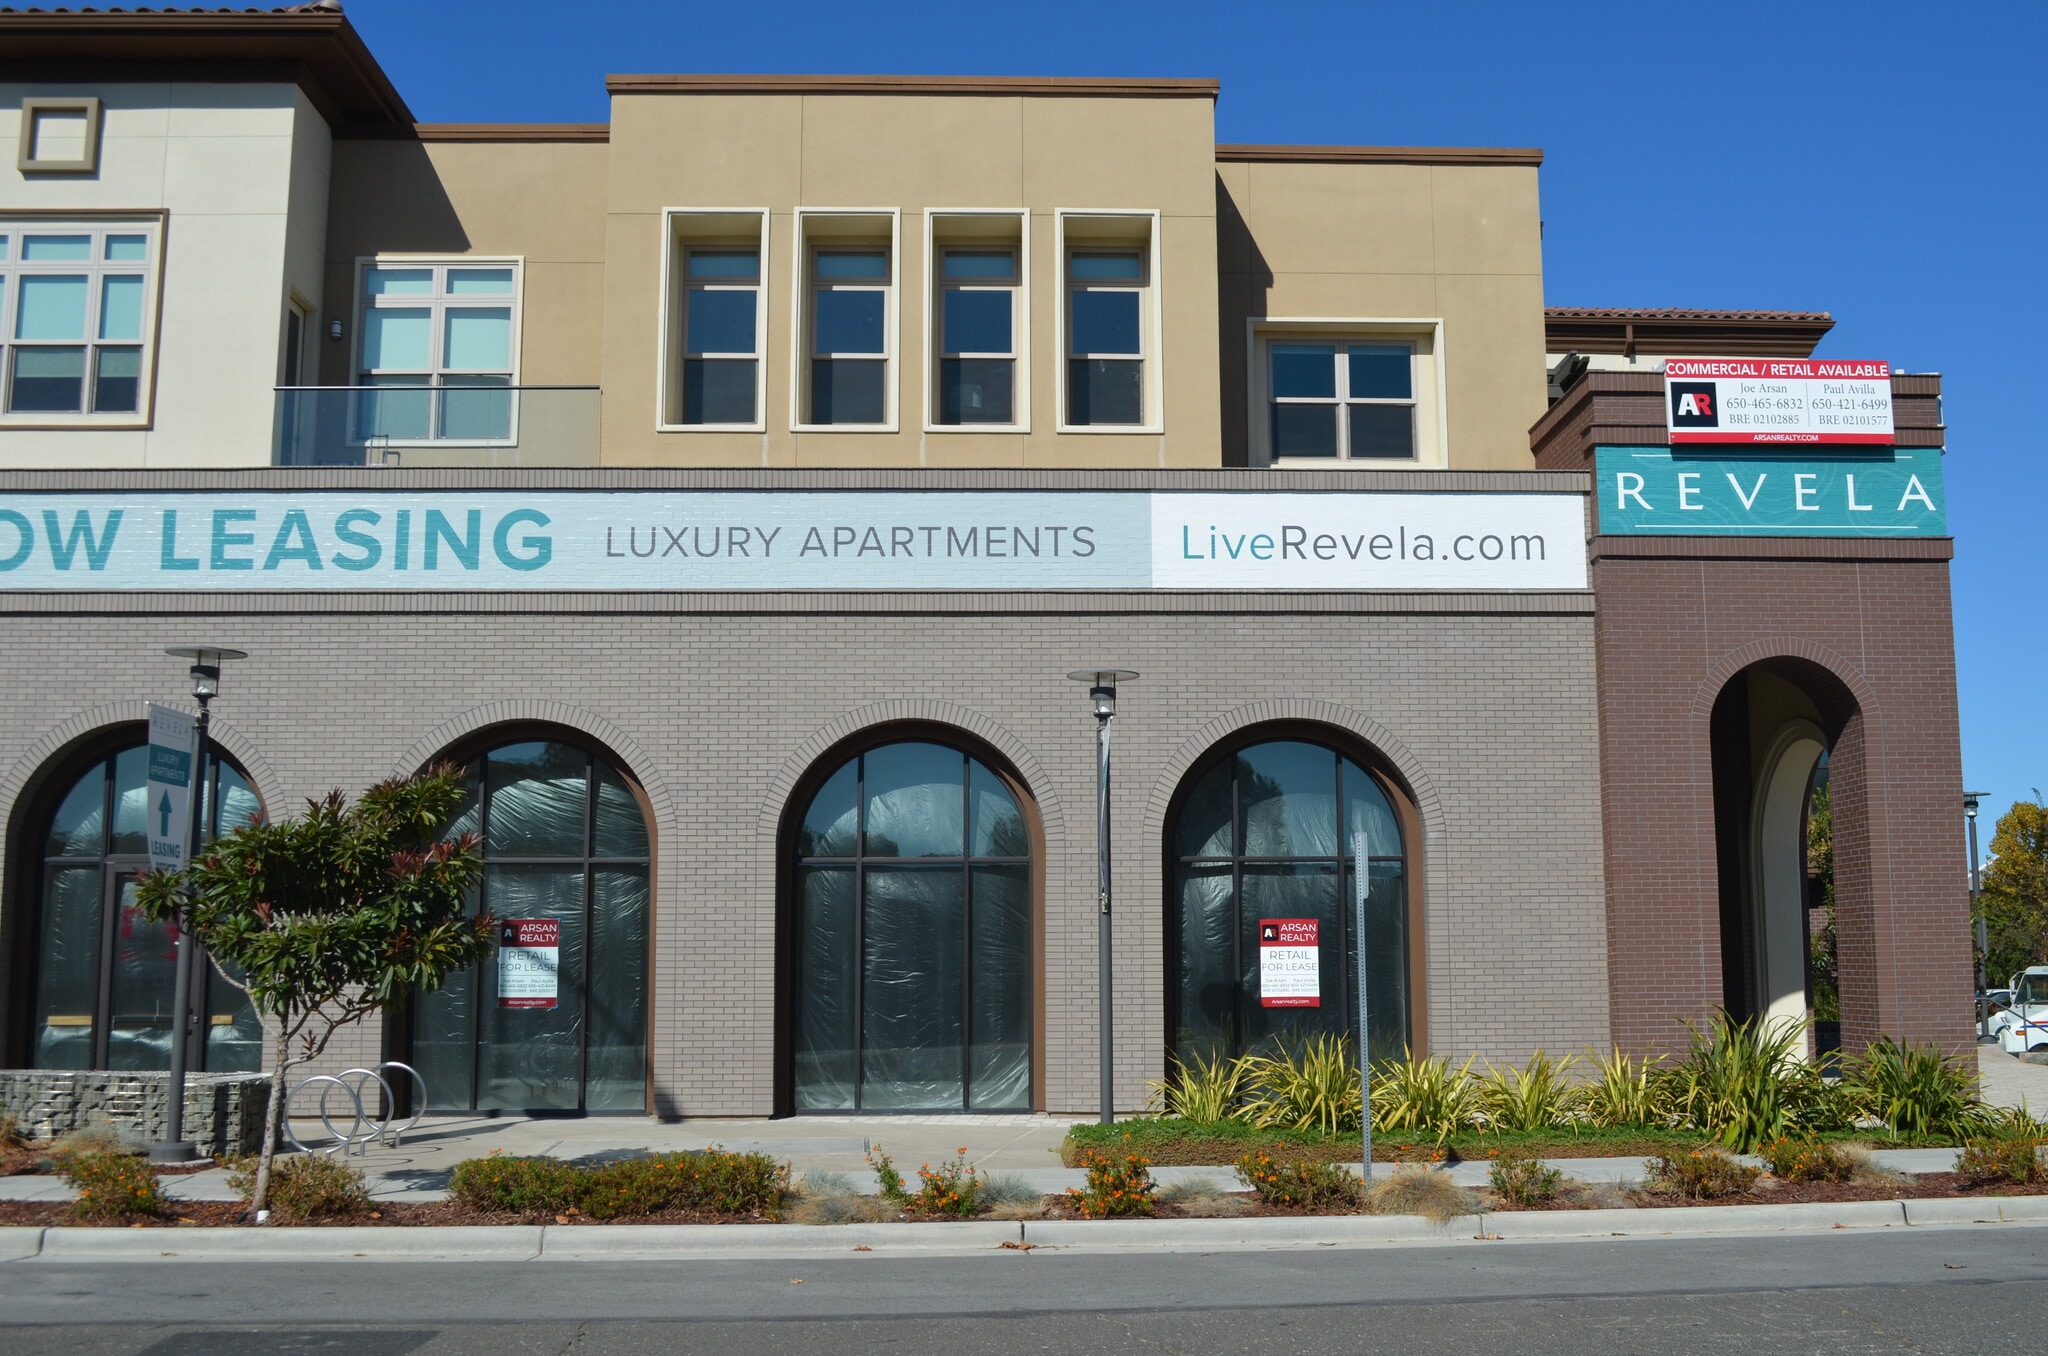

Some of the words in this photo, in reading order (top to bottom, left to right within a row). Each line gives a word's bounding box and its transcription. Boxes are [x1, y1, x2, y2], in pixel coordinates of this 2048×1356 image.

[1665, 362, 1759, 376] COMMERCIAL
[1770, 363, 1815, 376] RETAIL
[1817, 364, 1889, 376] AVAILABLE
[1740, 382, 1756, 395] Joe
[1759, 382, 1788, 394] Arsan
[1823, 383, 1845, 395] Paul
[1847, 384, 1876, 395] Avilla
[1677, 393, 1713, 416] AR
[1726, 397, 1803, 410] 650-465-6832
[1811, 398, 1888, 411] 650-421-6499
[1729, 413, 1751, 424] BRE
[1753, 414, 1800, 425] 02102885
[1818, 414, 1840, 425] BRE
[1842, 415, 1888, 426] 02101577
[1753, 434, 1819, 442] ARSANREALTY.COM
[1617, 472, 1936, 511] REVELA
[160, 508, 553, 571] LEASING
[606, 525, 781, 558] LUXURY
[800, 525, 1096, 558] APARTMENTS
[1182, 524, 1546, 561] LiveRevela.com
[152, 715, 190, 737] REVELA
[150, 840, 181, 859] LEASING
[521, 924, 557, 932] ARSAN
[1281, 924, 1316, 932] ARSAN
[520, 933, 557, 942] REALTY
[1280, 933, 1316, 942] REALTY
[508, 950, 551, 961] RETAIL
[1269, 950, 1312, 960] RETAIL
[500, 963, 522, 972] FOR
[524, 963, 557, 972] LEASE
[1261, 963, 1283, 971] FOR
[1285, 962, 1318, 971] LEASE
